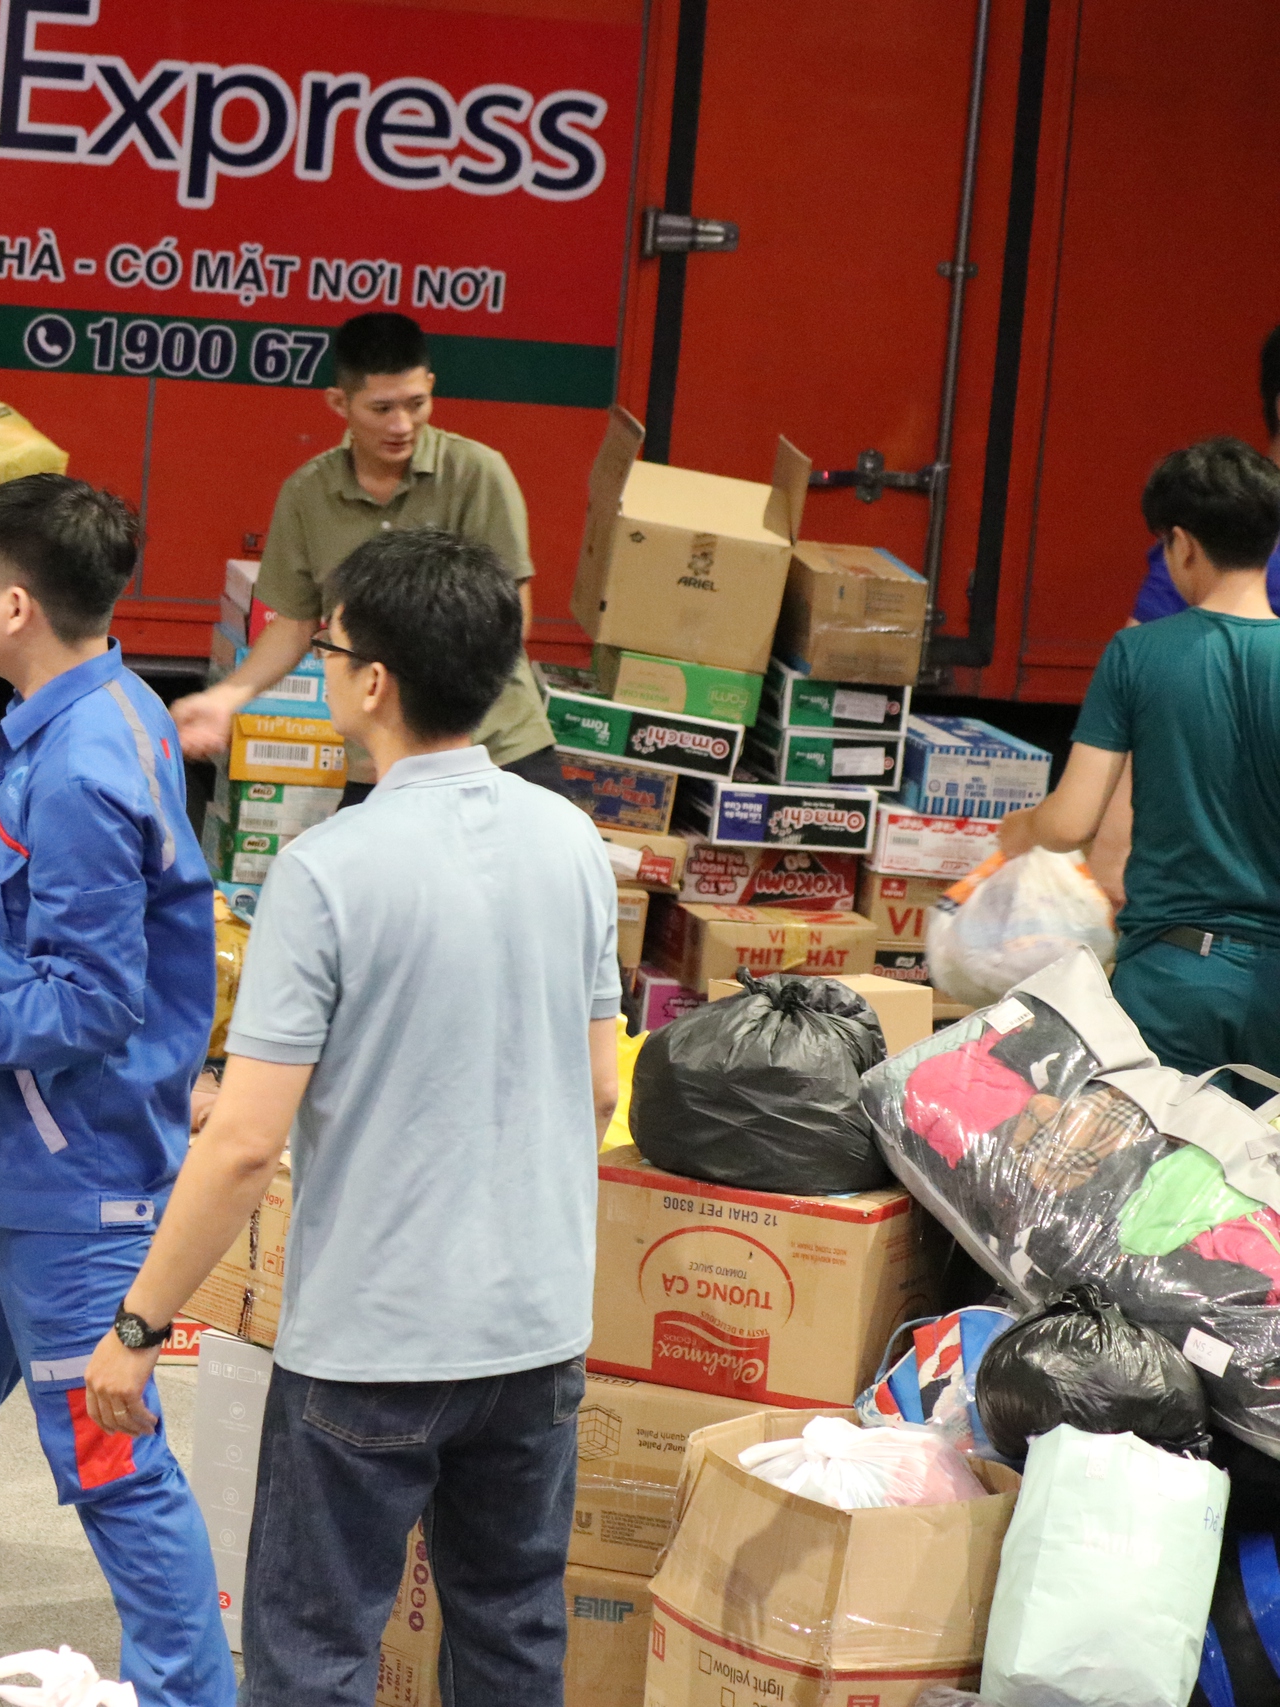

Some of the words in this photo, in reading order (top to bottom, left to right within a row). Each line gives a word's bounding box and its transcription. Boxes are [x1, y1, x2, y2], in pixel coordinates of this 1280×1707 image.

[107, 237, 180, 289] CÓ
[191, 242, 299, 305] MẶT
[310, 257, 400, 304] NƠI
[412, 265, 505, 313] NƠI
[89, 317, 236, 378] 1900
[251, 330, 330, 385] 67
[677, 575, 719, 592] ARIEL
[645, 726, 730, 760] Omachi
[781, 807, 866, 834] Omachi
[755, 870, 846, 896] KOKOMI
[663, 1196, 693, 1212] 830G
[700, 1203, 722, 1218] PET
[729, 1208, 758, 1224] CHAI
[764, 1213, 778, 1226] 12
[688, 1261, 712, 1274] SAUCE
[716, 1266, 747, 1279] TOMATO
[662, 1273, 690, 1298] CÀ
[697, 1279, 772, 1310] TƯƠNG
[700, 1311, 736, 1334] DELICIOUS
[663, 1334, 697, 1345] FOODS
[746, 1328, 769, 1337] TASTY
[657, 1340, 764, 1384] Cholimex
[636, 1428, 659, 1438] Pallet
[661, 1431, 685, 1441] quanh
[638, 1439, 662, 1450] Pallet
[711, 1660, 752, 1691] yellow
[753, 1674, 785, 1701] light
